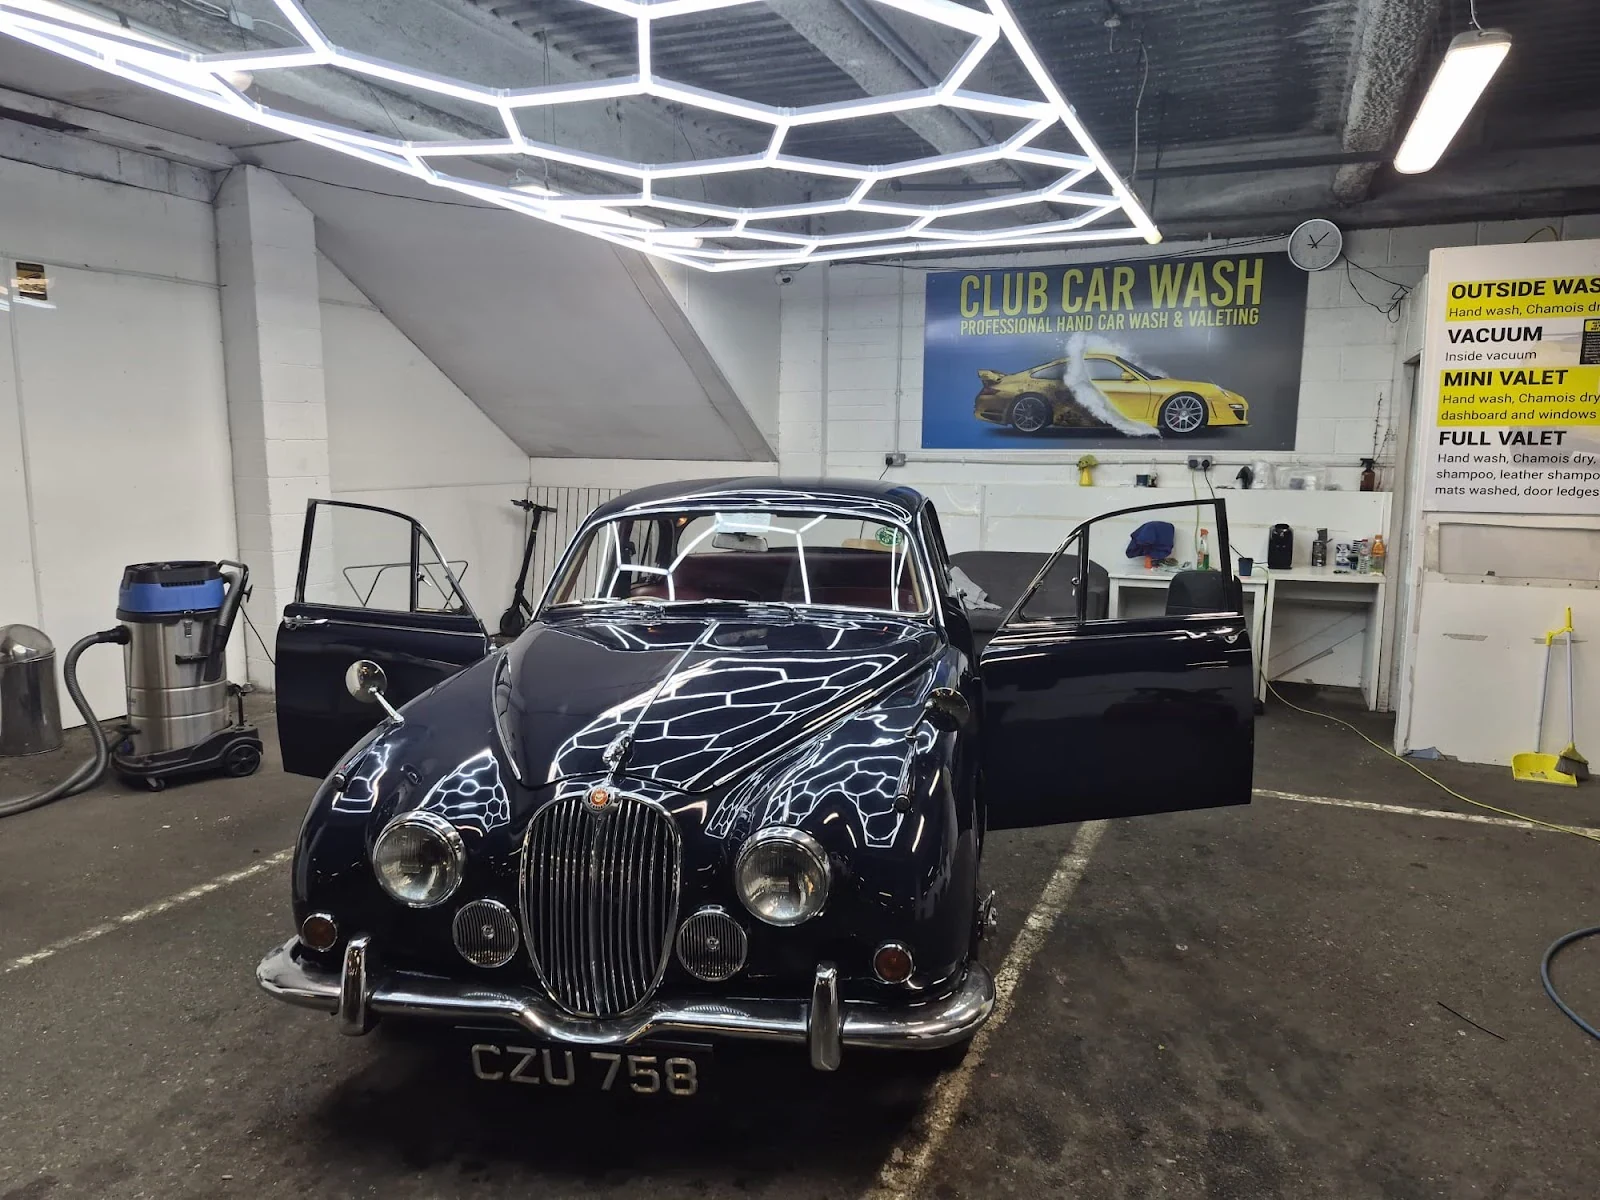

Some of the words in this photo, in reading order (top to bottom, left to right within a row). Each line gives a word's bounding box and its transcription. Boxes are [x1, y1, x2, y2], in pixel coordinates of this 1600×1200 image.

[960, 271, 1049, 318] CLUB
[1061, 266, 1136, 314] CAR
[1148, 258, 1264, 309] WASH
[1451, 280, 1546, 299] OUTSIDE
[1553, 277, 1600, 295] WAS
[1449, 307, 1482, 317] Hand
[1486, 304, 1522, 316] wash,
[1526, 302, 1584, 315] Chamois
[960, 316, 1053, 336] PROFESSIONAL
[1056, 314, 1094, 332] HAND
[1097, 313, 1125, 331] CAR
[1129, 311, 1169, 330] WASH
[1173, 310, 1184, 328] &
[1188, 307, 1260, 327] VALETING
[1448, 326, 1543, 344] VACUUM
[1445, 351, 1483, 361] Inside
[1486, 352, 1537, 360] vacuum
[1444, 371, 1493, 387] MINI
[1499, 370, 1568, 385] VALET
[1443, 394, 1475, 404] Hand
[1478, 393, 1515, 404] wash,
[1518, 393, 1576, 403] Chamois
[1579, 392, 1600, 404] dry
[1441, 411, 1507, 420] dashboard
[1511, 410, 1535, 420] and
[1538, 409, 1597, 419] windows
[1439, 431, 1491, 446] FULL
[1499, 431, 1567, 446] VALET
[1438, 453, 1470, 463] Hand
[1473, 453, 1509, 464] wash,
[1513, 453, 1570, 464] Chamois
[1573, 453, 1597, 466] dry,
[1436, 469, 1496, 481] shampoo,
[1500, 470, 1544, 479] leather
[1547, 470, 1600, 482] shampo
[1435, 486, 1466, 495] mats
[1469, 486, 1520, 497] washed,
[1523, 486, 1553, 496] door
[1556, 486, 1600, 499] ledges
[471, 1043, 576, 1086] CZU
[590, 1052, 699, 1096] 758
